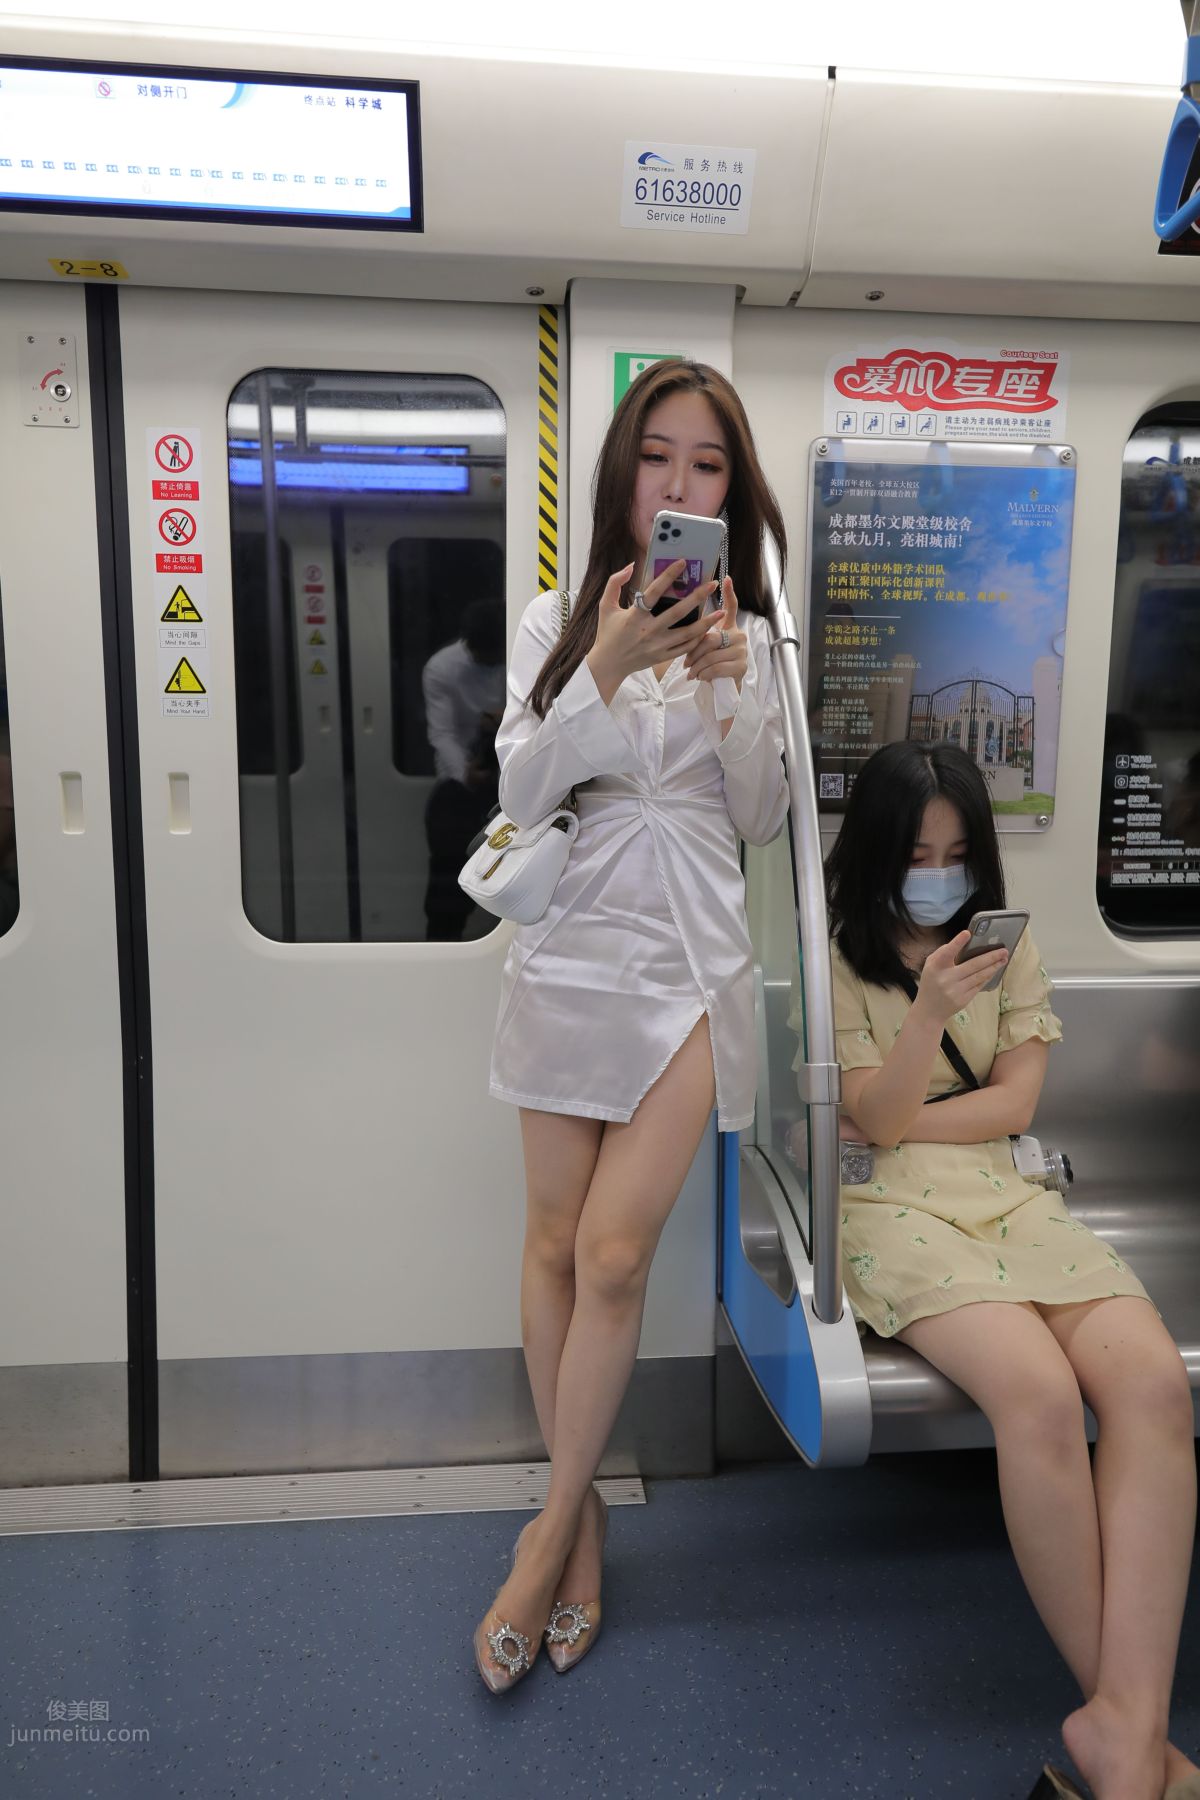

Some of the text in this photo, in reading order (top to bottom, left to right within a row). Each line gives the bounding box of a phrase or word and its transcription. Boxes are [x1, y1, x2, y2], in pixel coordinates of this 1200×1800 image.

[137, 84, 188, 100] 对侧开门
[304, 94, 383, 111] 终点站 科学城
[684, 158, 743, 174] 服务热线
[635, 177, 741, 206] 61638000
[647, 209, 726, 225] Service Hotline
[59, 261, 119, 277] 2-8
[1001, 350, 1058, 360] Courtesy Seat
[846, 358, 1047, 401] 爱心专座
[945, 416, 1051, 428] 请主动为老弱病残孕乘客让座
[160, 482, 192, 491] 禁止倚靠
[1008, 502, 1059, 513] MALVERN
[828, 513, 972, 532] 成都墨尔文殿堂级校舍
[163, 555, 195, 564] 禁止吸烟
[827, 562, 946, 576] 全球优质中外籍学术团队
[827, 575, 945, 588] 中西汇聚国际化创新课程
[824, 624, 896, 635] 学霸之路不止一条
[171, 700, 201, 708] 当心夹手
